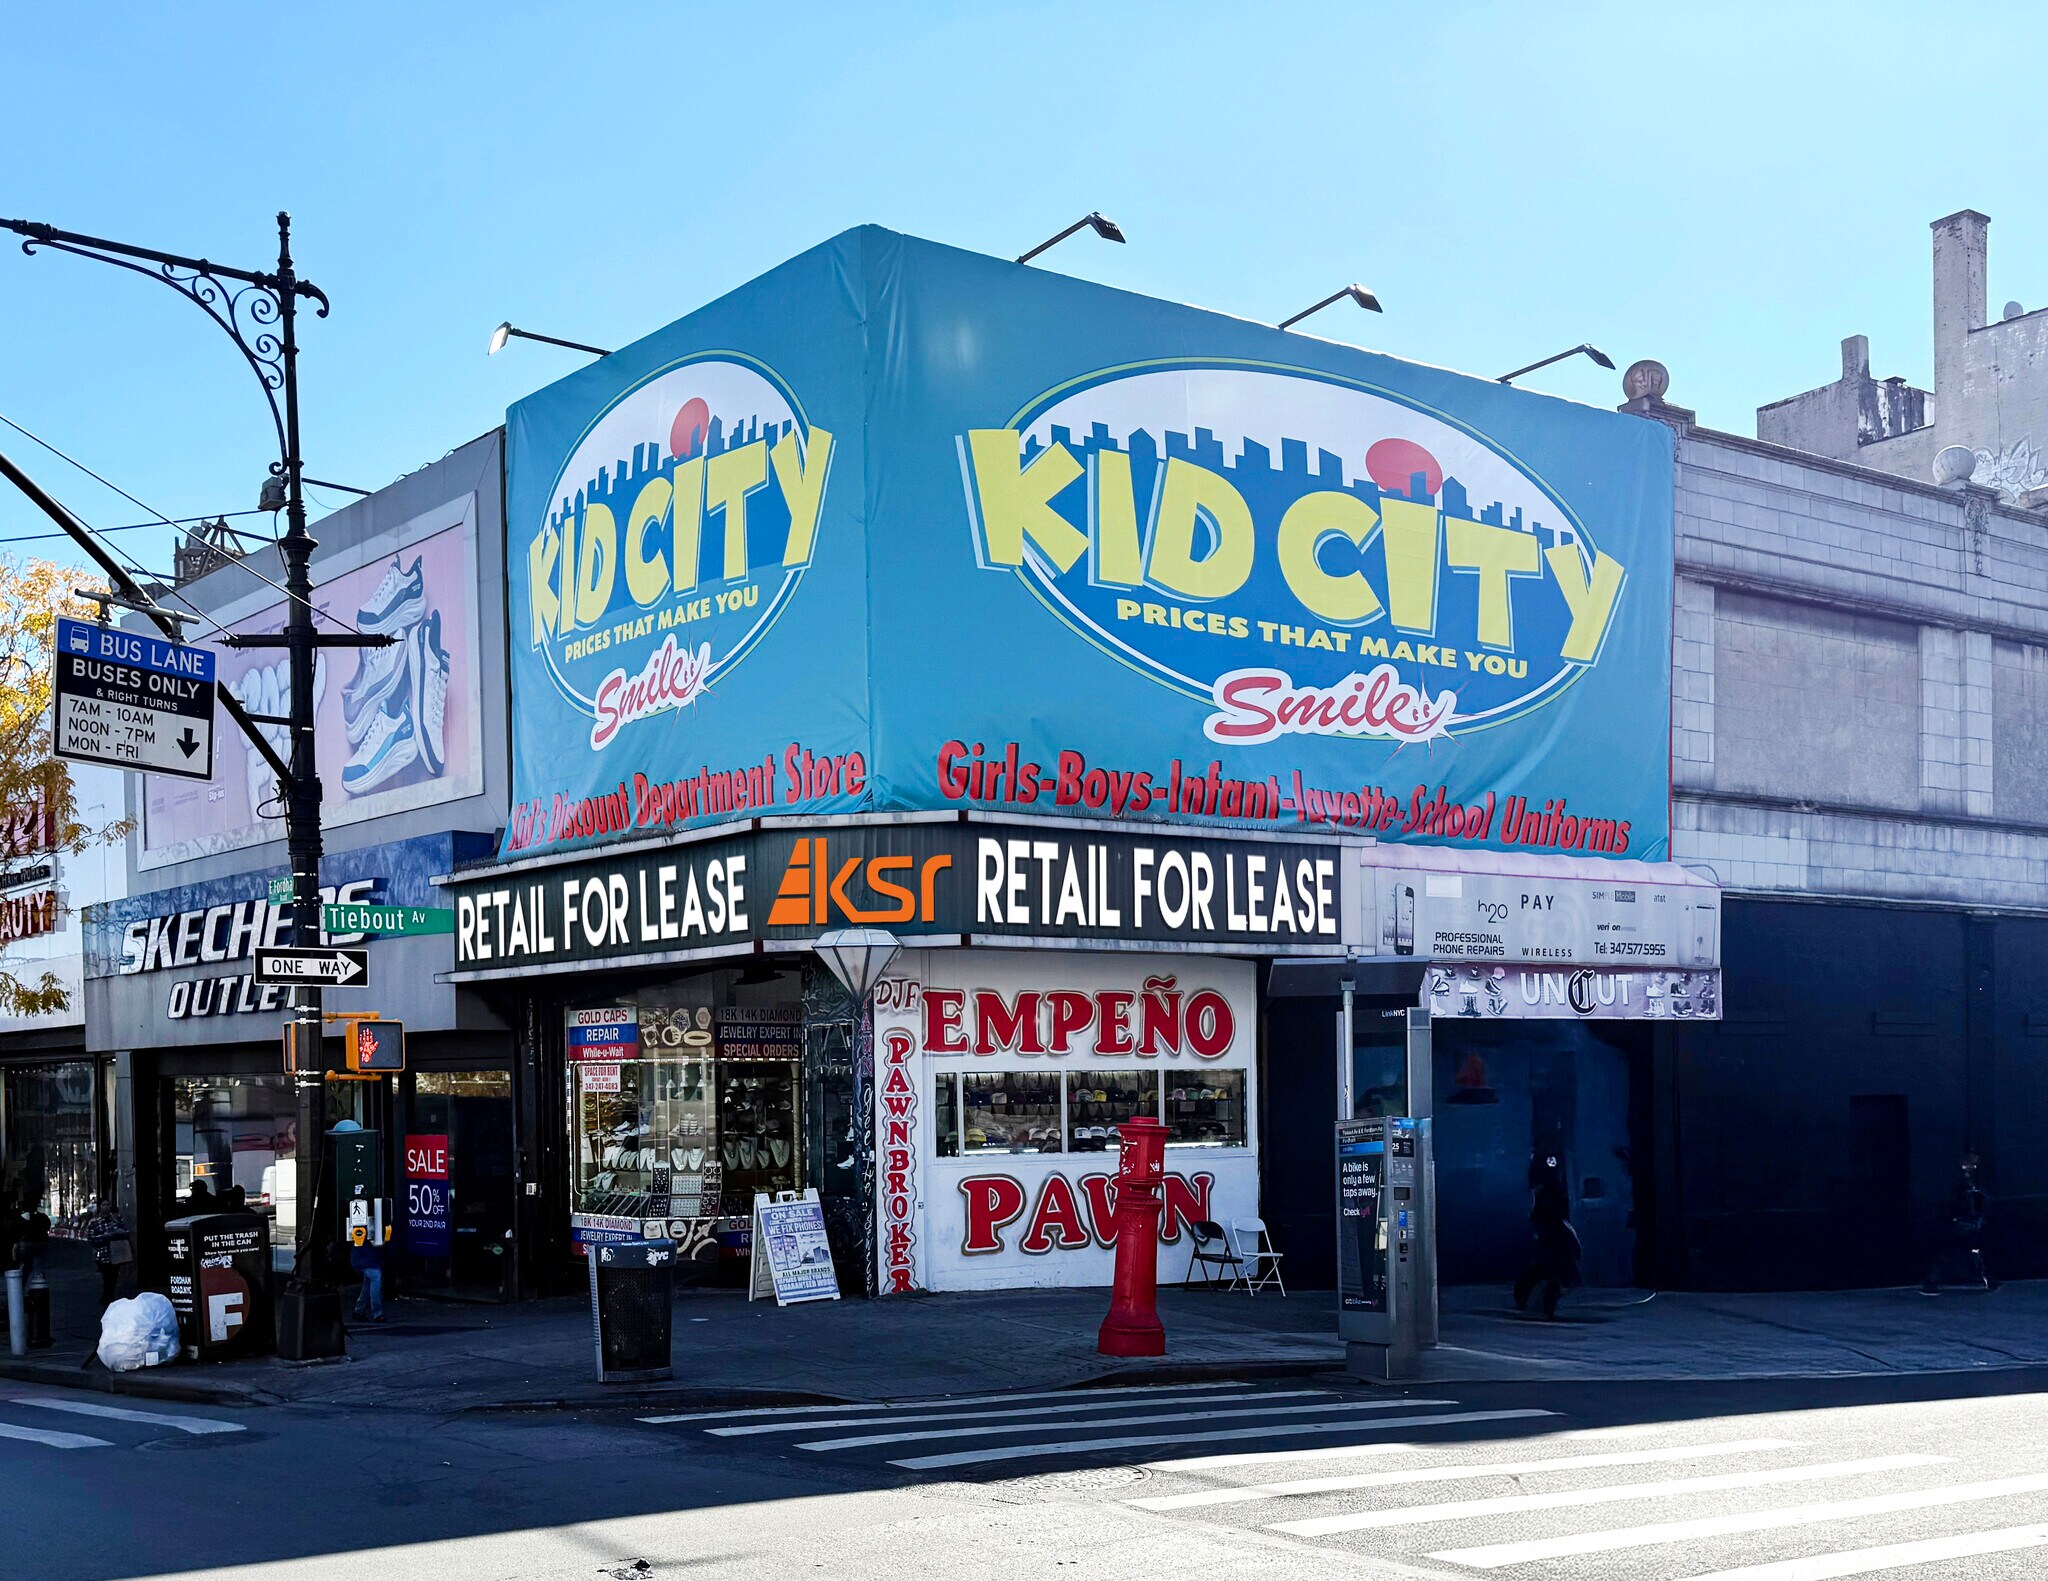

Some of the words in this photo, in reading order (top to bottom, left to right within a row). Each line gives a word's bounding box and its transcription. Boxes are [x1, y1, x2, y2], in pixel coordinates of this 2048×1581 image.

[527, 504, 617, 651] KID
[625, 424, 836, 610] CITY
[956, 429, 1255, 602] KID
[1278, 489, 1627, 667] CITY
[564, 632, 610, 663] PRICES
[613, 614, 653, 645] THAT
[656, 594, 710, 629] MAKE
[716, 585, 759, 614] YOU
[1117, 601, 1250, 639] PRICES
[1257, 620, 1351, 654] THAT
[1360, 637, 1458, 670] MAKE
[1465, 650, 1528, 679] YOU
[100, 633, 142, 662] BUS
[151, 645, 204, 676] LANE
[72, 658, 142, 688] BUSES
[149, 674, 200, 700] ONLY
[96, 688, 104, 698] &
[108, 689, 139, 704] RIGHT
[143, 696, 178, 711] TURNS
[593, 641, 702, 745] Smile
[1210, 666, 1450, 739] Smile
[70, 699, 100, 717] 7AM
[116, 708, 154, 726] 10AM
[68, 716, 110, 736] NOON
[125, 727, 156, 744] 7PM
[68, 735, 100, 751] MON
[116, 744, 139, 758] FRI
[550, 780, 629, 841] Discount
[635, 753, 776, 827] Department
[784, 743, 866, 804] Store
[1500, 792, 1631, 854] Uniforms
[977, 837, 1121, 929] RETAIL
[1133, 847, 1215, 930] FOR
[1226, 853, 1336, 934] LEASE
[458, 884, 555, 962] RETAIL
[563, 872, 630, 950] FOR
[639, 855, 749, 940] LEASE
[1520, 894, 1554, 910] PAY
[329, 907, 404, 930] Tiebout
[412, 911, 426, 924] Av
[1435, 932, 1503, 944] PROFESSIONAL
[1433, 944, 1464, 954] PHONE
[1466, 945, 1504, 956] REPAIRS
[1522, 948, 1572, 958] WIRELESS
[1594, 942, 1608, 954] Tel:
[271, 959, 304, 974] ONE
[319, 960, 352, 976] WAY
[876, 978, 921, 1010] DJF
[1520, 968, 1634, 1016] UNCUT
[578, 1011, 601, 1024] GOLD
[604, 1008, 628, 1022] CAPS
[720, 1009, 738, 1021] 18K
[740, 1009, 758, 1021] 14K
[760, 1008, 801, 1022] DIAMOND
[921, 975, 1236, 1060] EMPEÑO
[1382, 1008, 1406, 1018] LinkNYC
[586, 1028, 619, 1042] REPAIR
[720, 1026, 757, 1039] JEWELRY
[760, 1026, 790, 1040] EXPERT
[724, 1044, 761, 1057] SPECIAL
[764, 1044, 799, 1057] ORDERS
[407, 1149, 446, 1173] SALE
[884, 1035, 918, 1292] PAWNBROKER
[1342, 1163, 1348, 1172] A
[1348, 1162, 1362, 1172] bike
[1363, 1162, 1368, 1171] is
[1343, 1174, 1357, 1186] only
[1362, 1174, 1376, 1184] few
[1343, 1188, 1357, 1198] taps
[1358, 1188, 1378, 1198] away.
[432, 1205, 444, 1215] OFF
[771, 1211, 786, 1220] ON
[789, 1208, 814, 1218] SALE
[1343, 1208, 1360, 1216] Check
[408, 1219, 423, 1228] YOUR
[434, 1220, 446, 1229] PAIR
[580, 1217, 592, 1228] 18K
[592, 1217, 604, 1228] 14K
[604, 1218, 633, 1230] DIAMOND
[729, 1220, 753, 1230] GOL
[769, 1224, 782, 1235] WE
[782, 1223, 793, 1233] FIX
[235, 1231, 258, 1239] TRASH
[580, 1231, 604, 1242] JEWELRY
[604, 1232, 626, 1242] EXPERT
[208, 1292, 244, 1342] F
